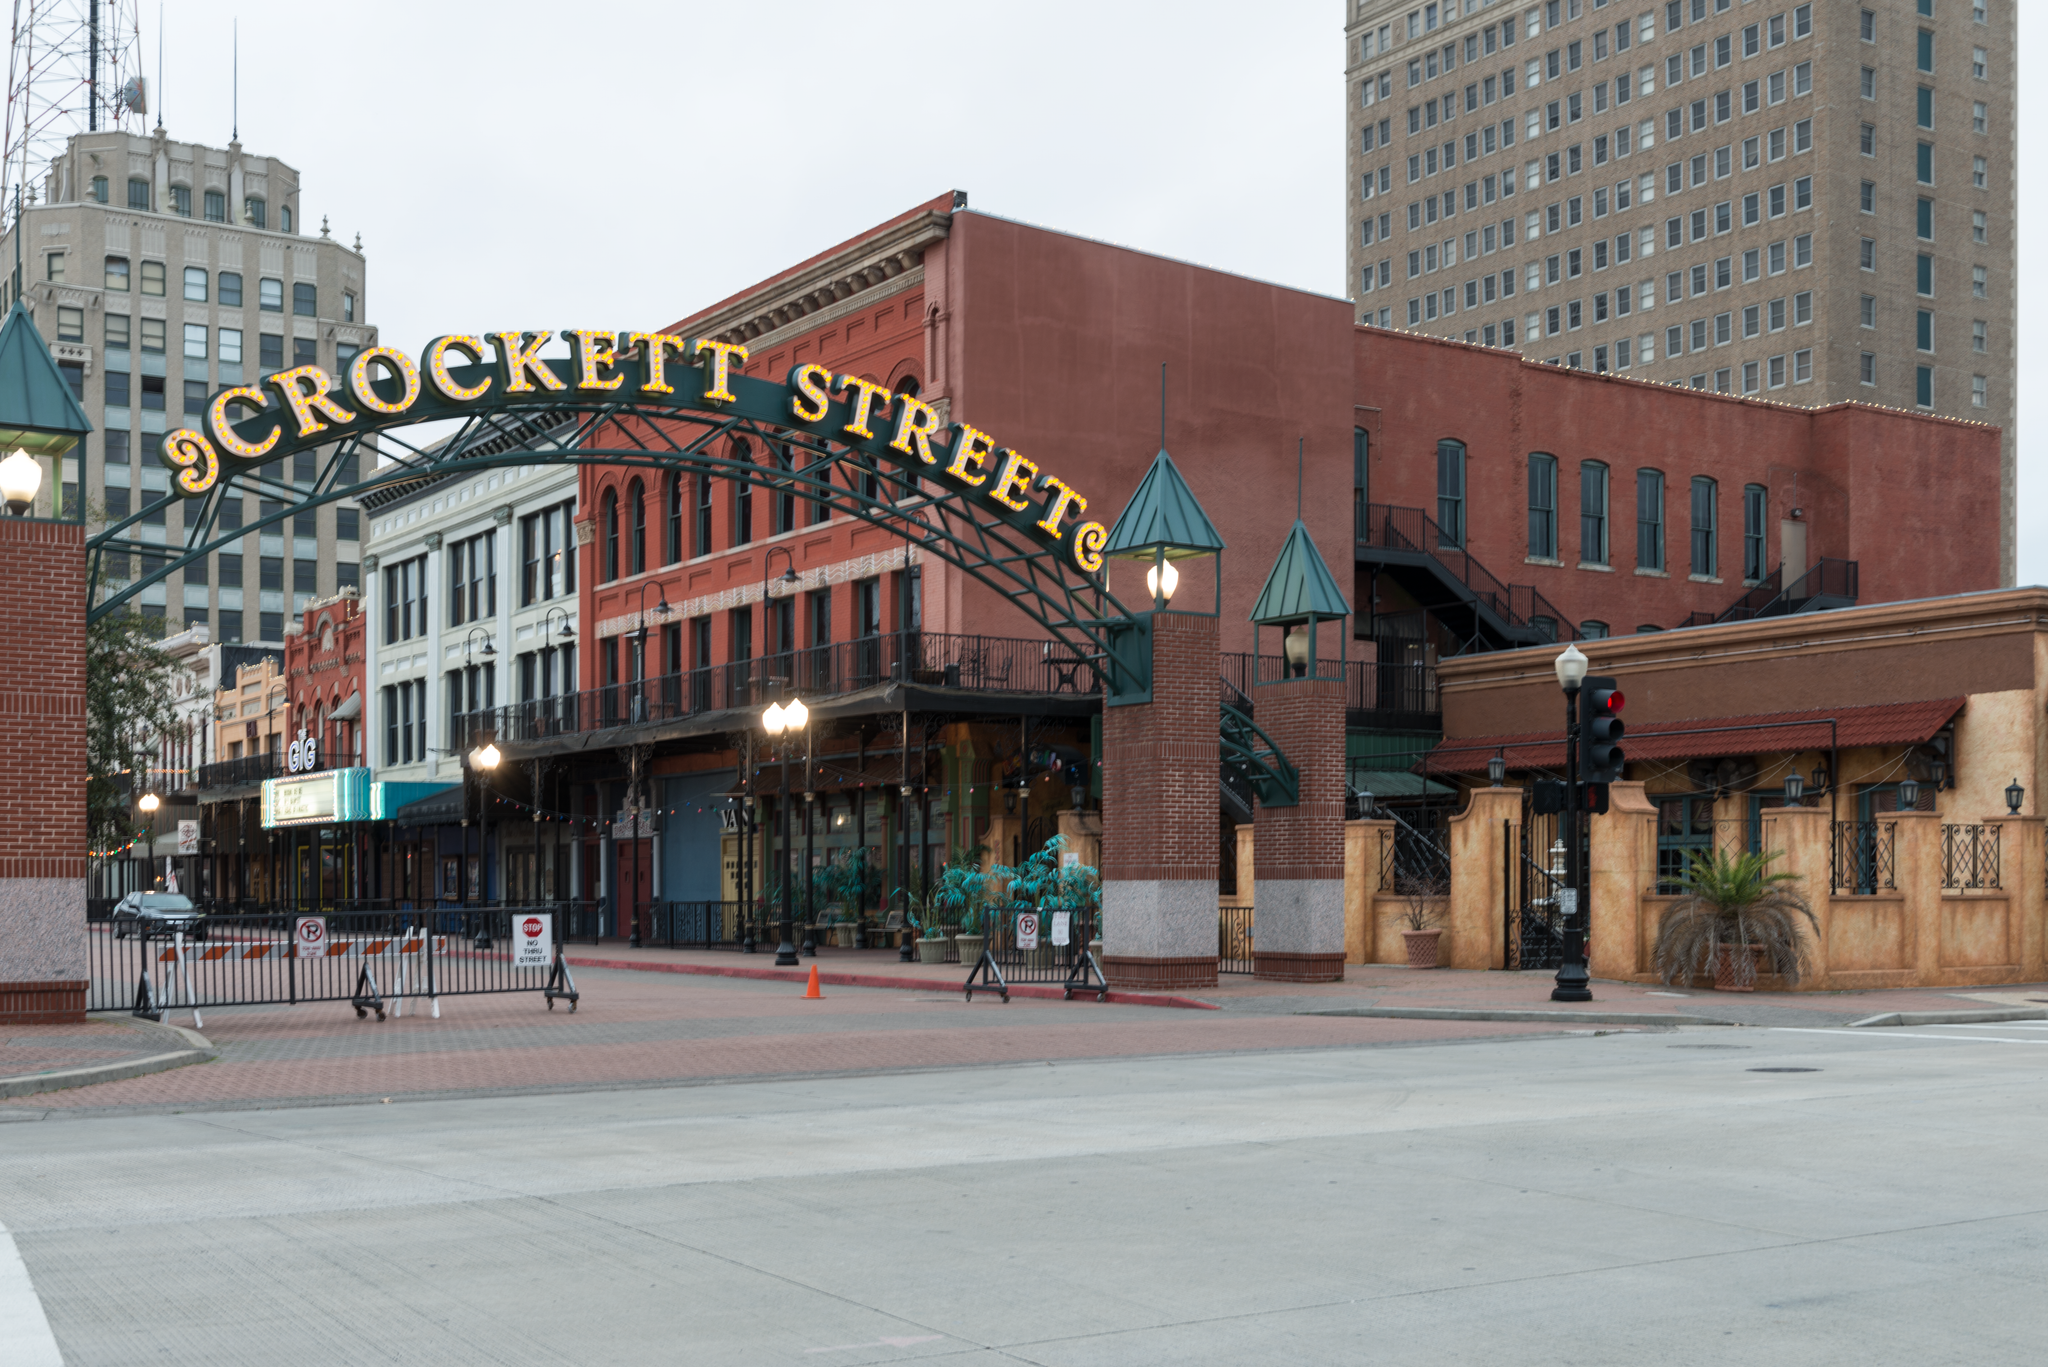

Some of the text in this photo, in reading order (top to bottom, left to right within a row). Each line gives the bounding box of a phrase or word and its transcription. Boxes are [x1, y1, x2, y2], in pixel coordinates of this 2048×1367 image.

[203, 329, 1088, 540] CROCKETT STREET
[288, 737, 316, 772] GIG
[522, 923, 543, 933] STOP
[526, 939, 539, 947] NO
[523, 947, 543, 955] THRU
[519, 955, 547, 964] STREET
